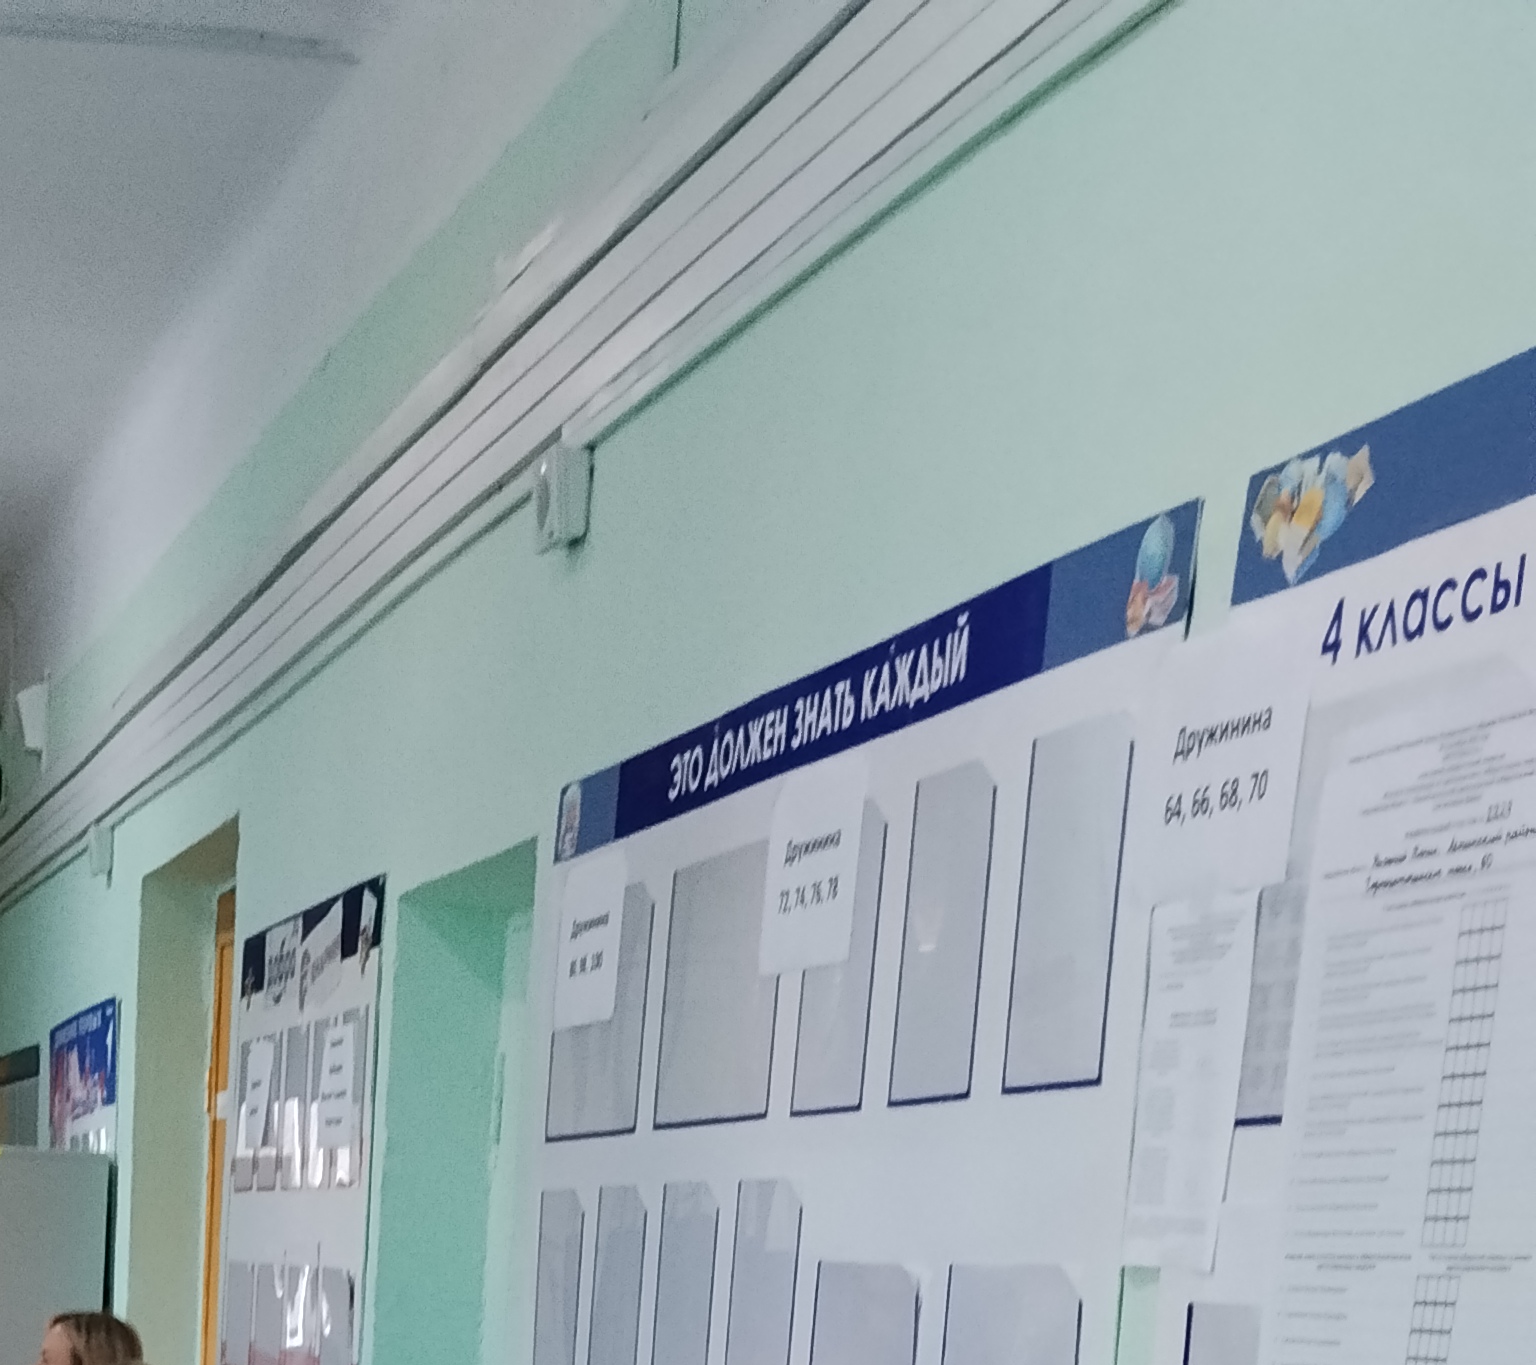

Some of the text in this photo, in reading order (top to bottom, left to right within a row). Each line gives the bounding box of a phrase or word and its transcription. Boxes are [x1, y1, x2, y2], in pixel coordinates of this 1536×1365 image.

[1321, 552, 1527, 667] 4 классы
[667, 610, 970, 802] ЭТО ДОЛЖЕН ЗНАТЬ КАЖДЫЙ
[1172, 704, 1274, 765] Дружинина
[1164, 768, 1269, 826] 64, 66, 68, 70
